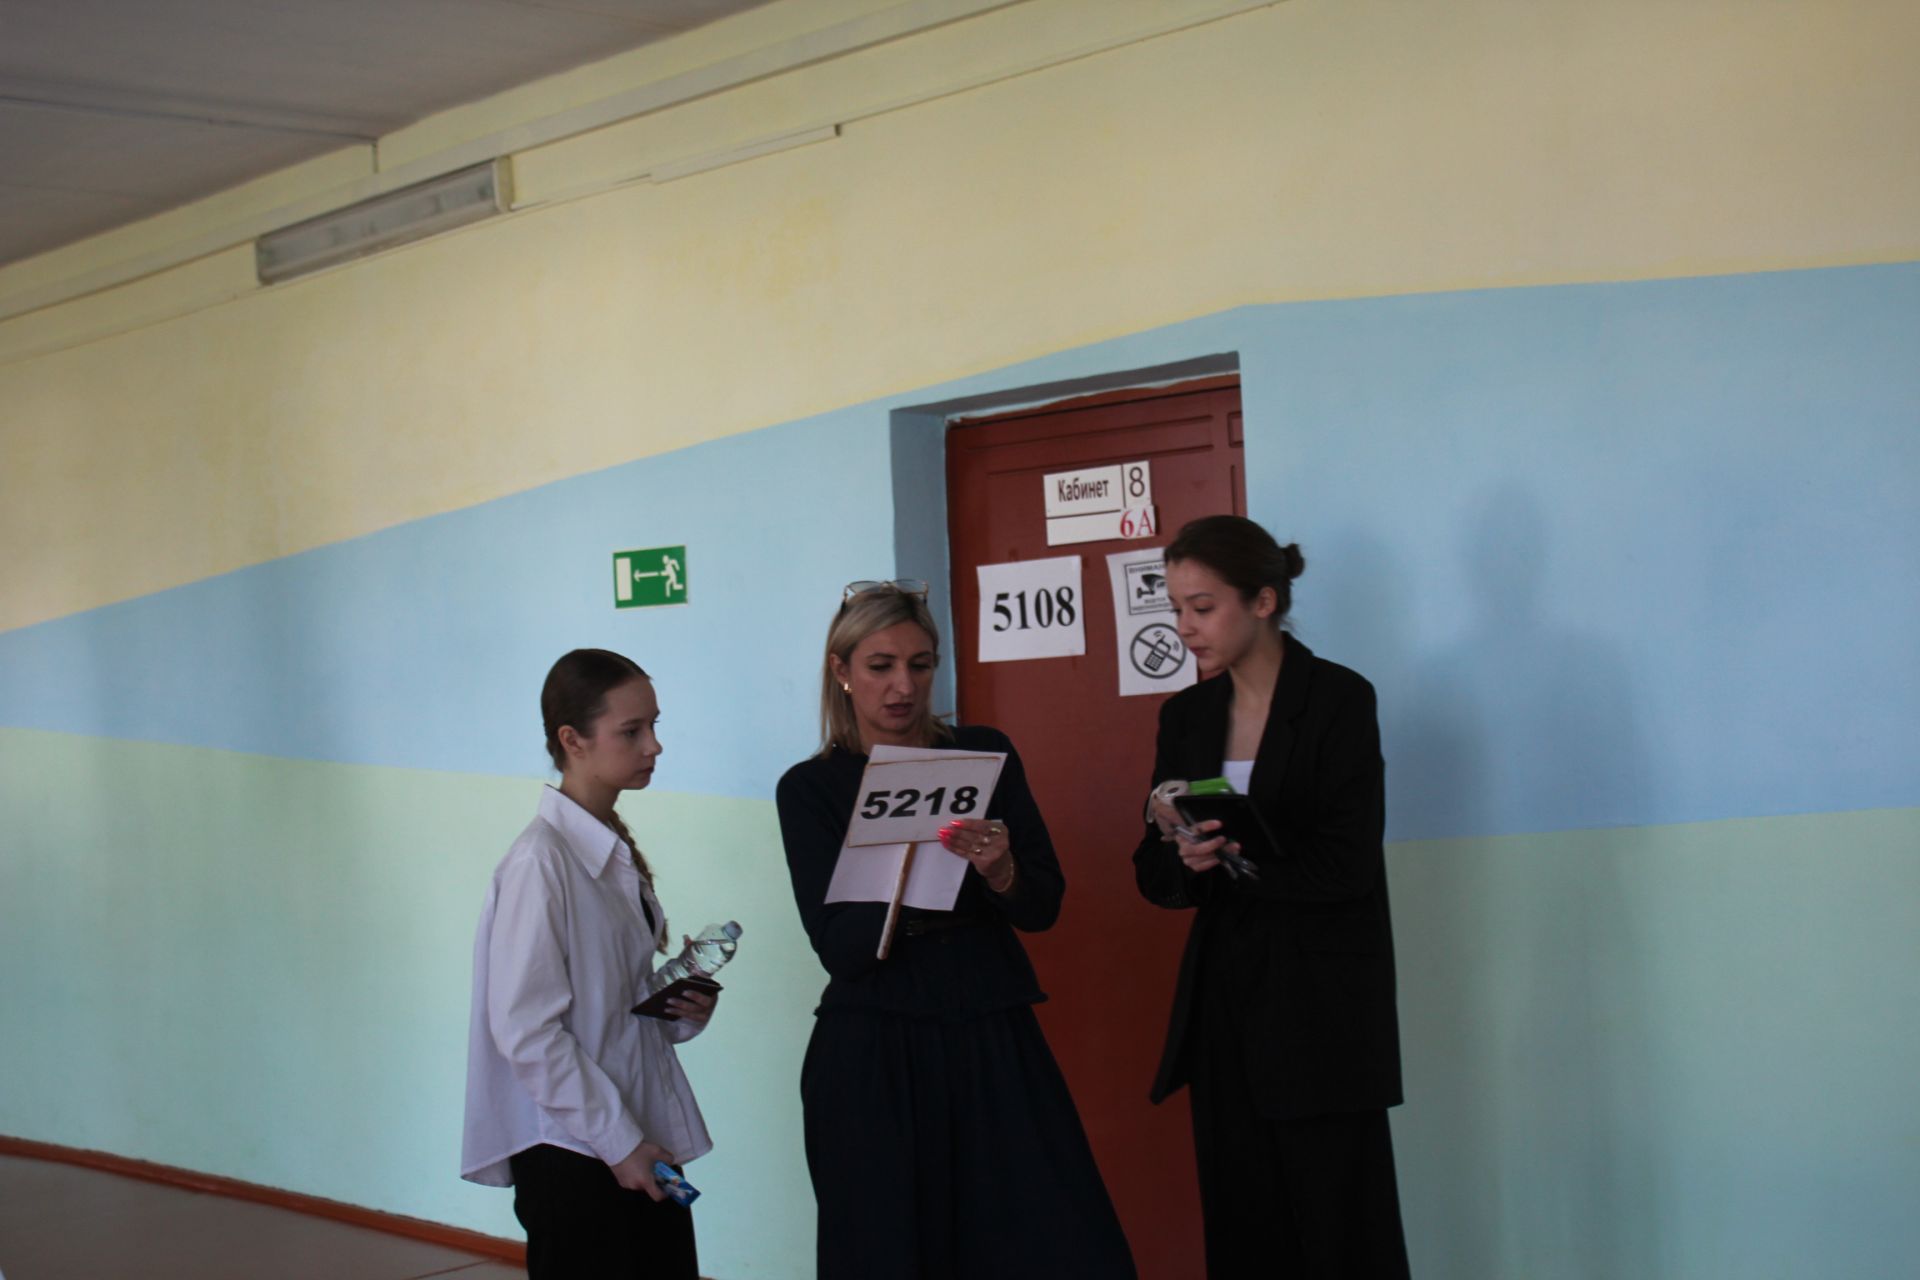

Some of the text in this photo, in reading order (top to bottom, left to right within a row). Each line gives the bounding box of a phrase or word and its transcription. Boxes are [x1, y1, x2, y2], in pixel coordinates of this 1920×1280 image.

[1058, 466, 1146, 502] Кабинет 8
[1120, 508, 1154, 538] 6А
[993, 586, 1075, 632] 5108
[860, 786, 978, 819] 5218
